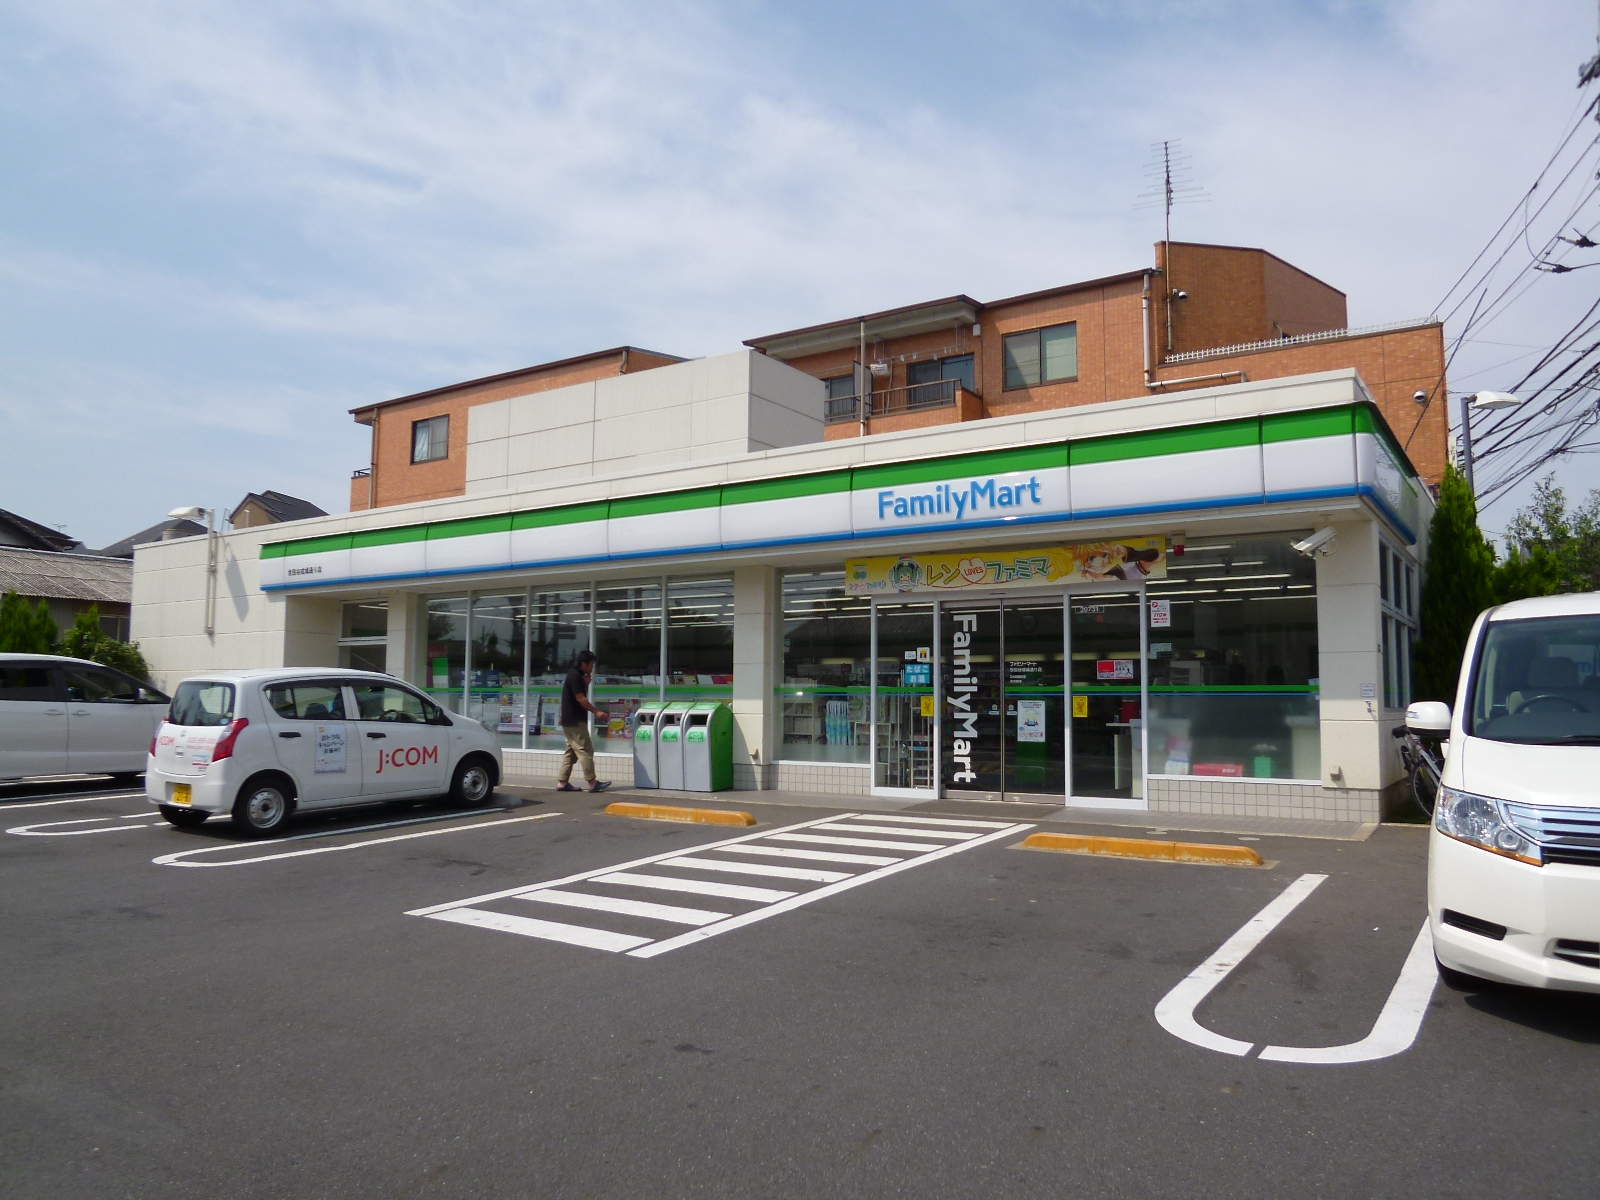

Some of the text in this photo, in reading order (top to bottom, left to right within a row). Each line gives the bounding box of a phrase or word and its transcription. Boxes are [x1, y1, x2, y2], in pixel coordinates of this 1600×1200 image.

[878, 476, 1041, 519] FamilyMart
[926, 556, 1050, 586] レン LOVES ファミマ
[906, 665, 928, 673] たばこ
[946, 614, 978, 783] FamilyMart
[318, 740, 345, 748] キャンペーン
[375, 745, 438, 773] J:COM
